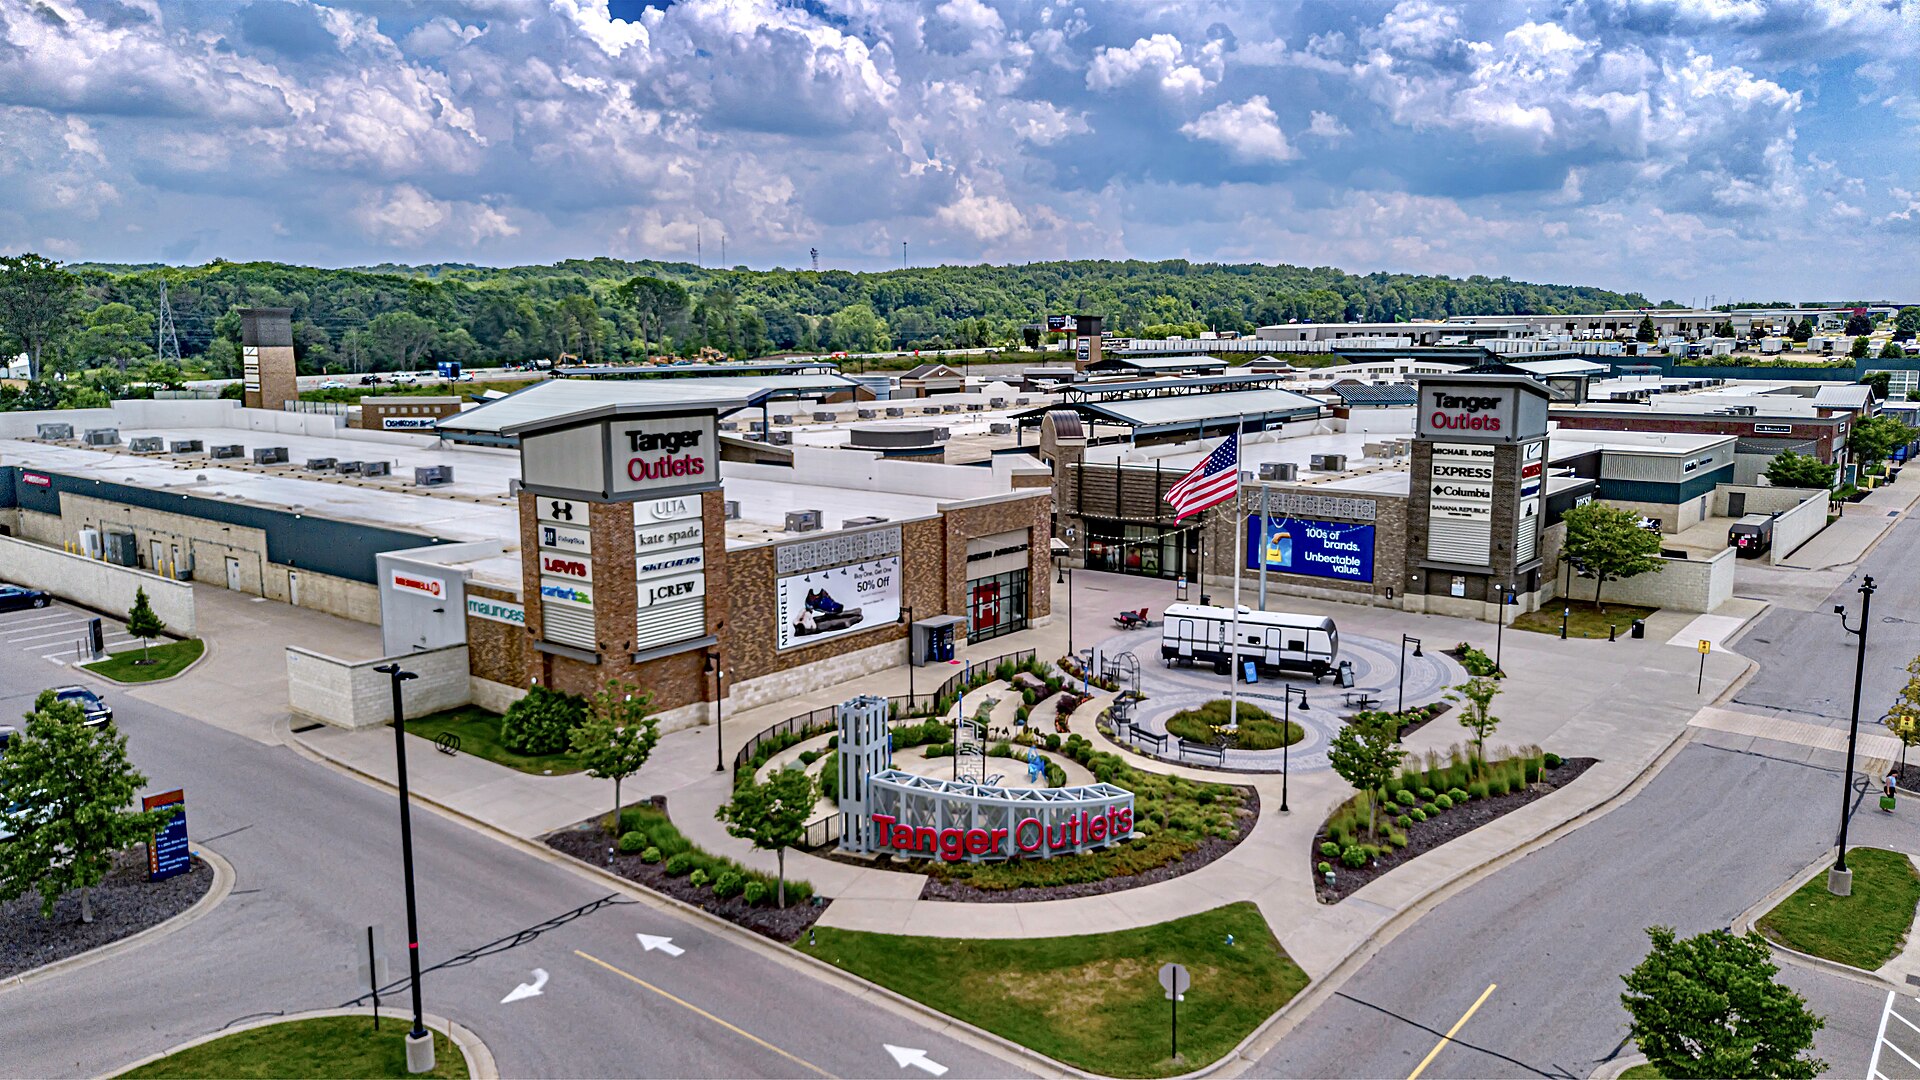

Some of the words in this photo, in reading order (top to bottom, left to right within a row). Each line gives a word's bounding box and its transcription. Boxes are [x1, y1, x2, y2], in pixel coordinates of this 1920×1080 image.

[1432, 392, 1502, 413] Tanger
[1431, 411, 1501, 431] Outlets
[625, 430, 703, 454] Tanger
[1432, 448, 1469, 456] MICHAEL
[627, 454, 705, 482] Outlets
[1433, 465, 1492, 479] EXPRESS
[1443, 486, 1490, 498] Columbia
[656, 499, 686, 514] ULTA
[1459, 506, 1489, 514] REPUBLIC
[639, 534, 665, 546] kate
[667, 526, 700, 544] spade
[1306, 529, 1327, 539] 100s
[1329, 531, 1340, 540] of
[1323, 539, 1360, 552] brands.
[640, 556, 701, 573] SKECHERS
[1304, 551, 1360, 566] Unbeatable
[1332, 565, 1360, 576] value.
[857, 580, 875, 592] 50%
[876, 576, 890, 588] Off
[779, 579, 788, 646] MERRELL
[872, 813, 1008, 862] Tanger
[1016, 804, 1133, 852] Outlets
